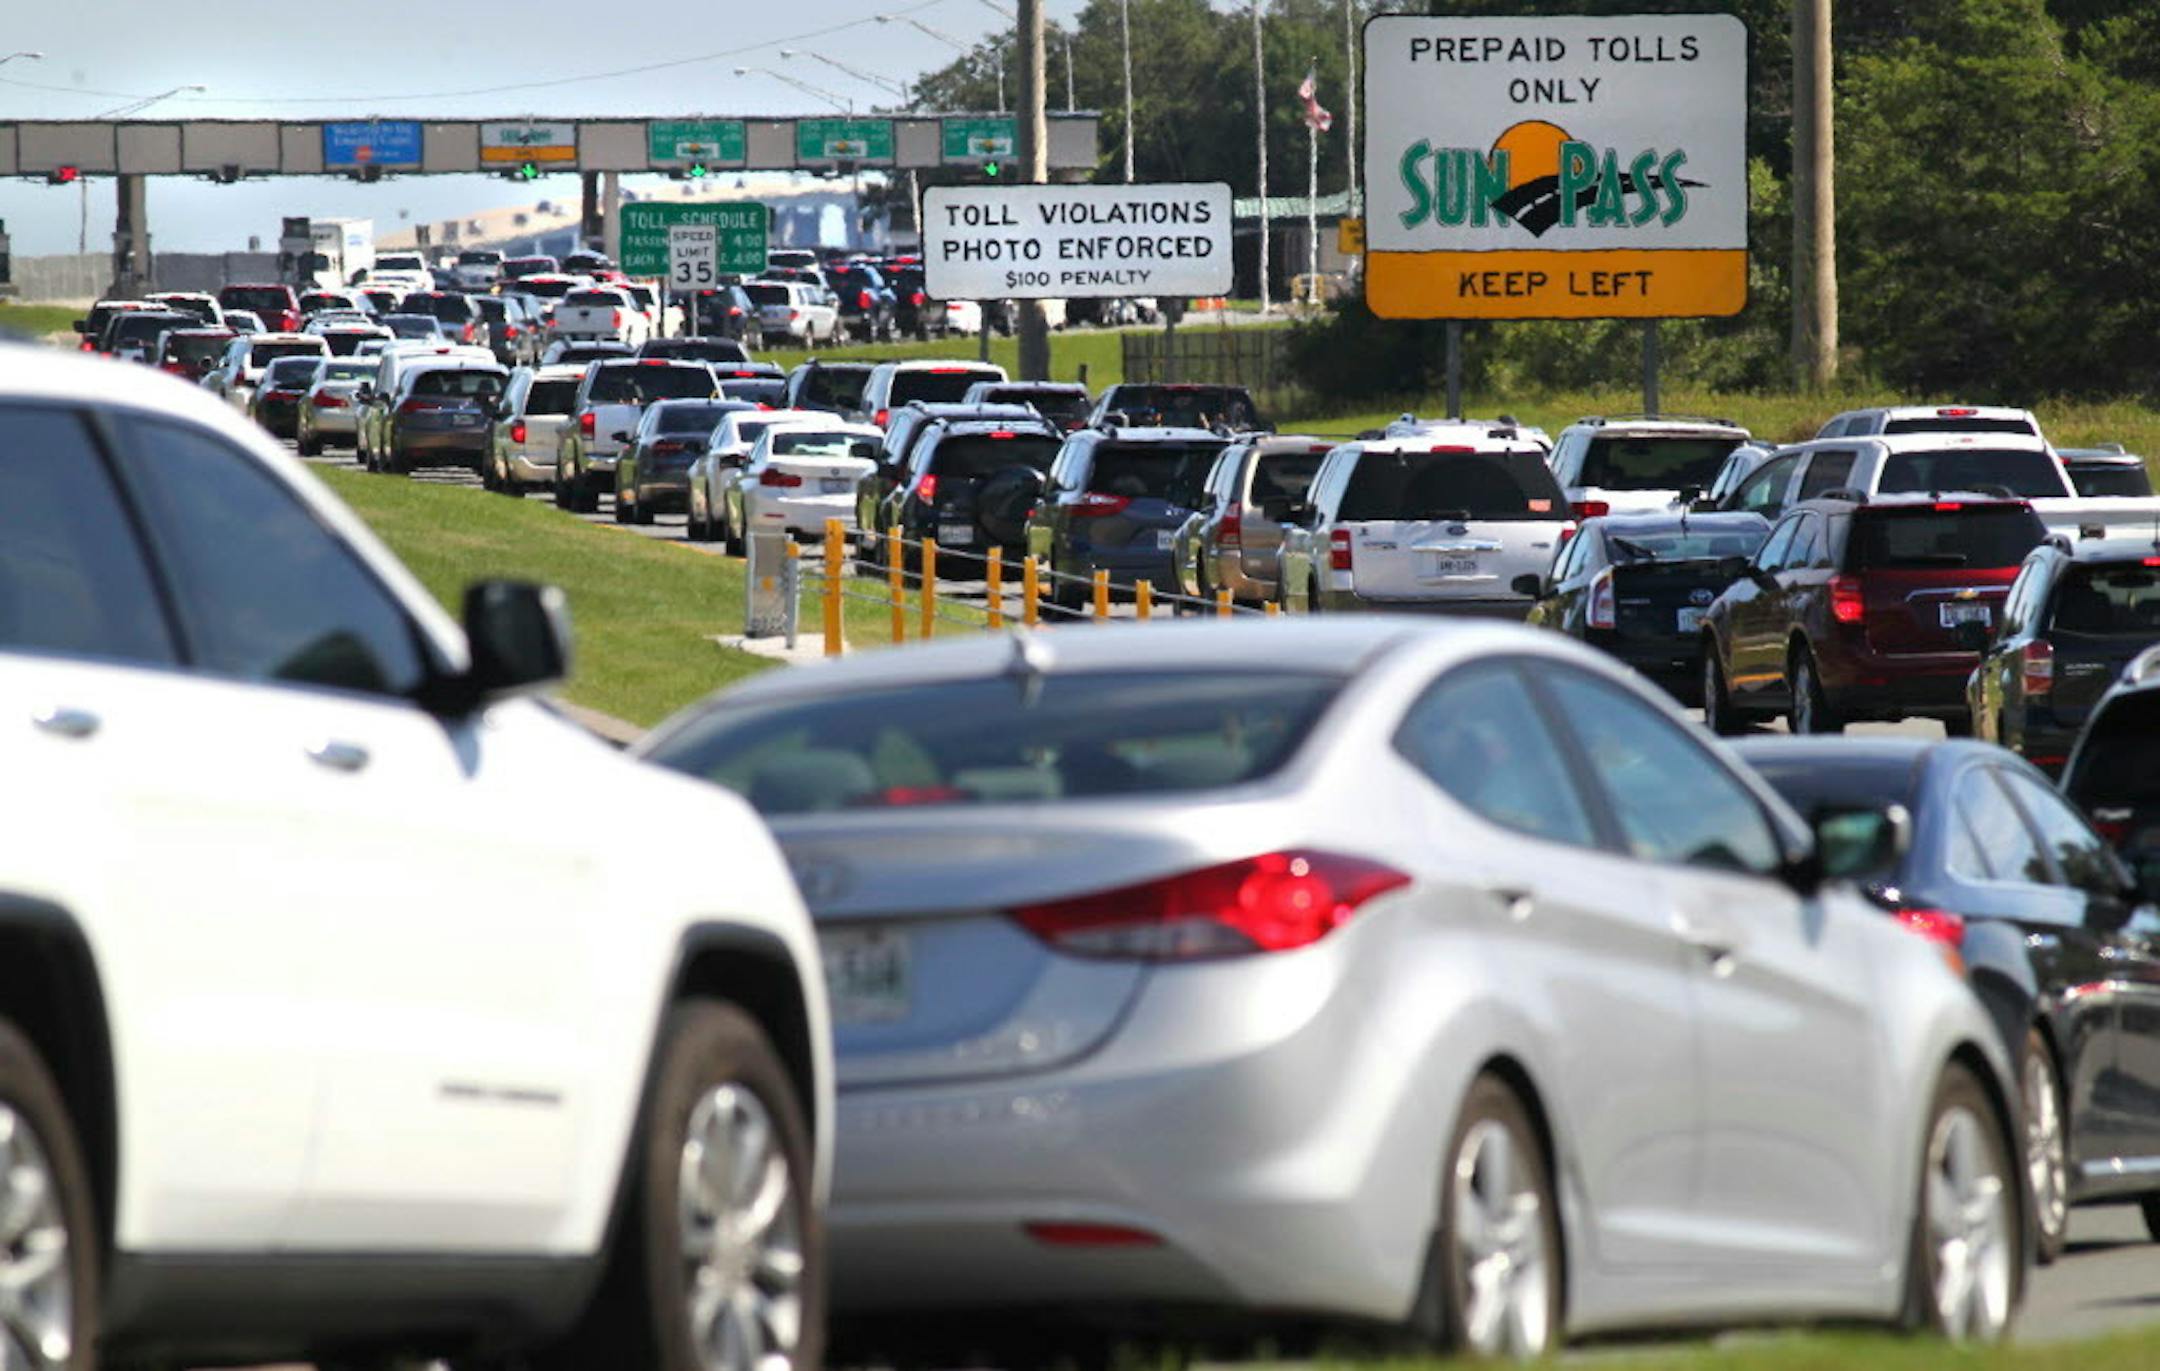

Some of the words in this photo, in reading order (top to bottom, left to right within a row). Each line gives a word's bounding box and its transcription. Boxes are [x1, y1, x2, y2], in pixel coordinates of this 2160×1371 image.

[1410, 36, 1566, 62] PREPAID
[1588, 35, 1700, 62] TOLLS
[1509, 77, 1601, 104] ONLY
[1399, 138, 1511, 230] SUN
[1559, 139, 1689, 229] PASS
[628, 211, 666, 229] TOLL
[680, 211, 759, 229] SCHEDULE
[945, 204, 1018, 227] TOLL
[1039, 200, 1212, 225] VIOLATIONS
[626, 236, 671, 249] PASSEN
[673, 230, 714, 242] SPEED
[676, 247, 710, 259] LIMIT
[943, 238, 1041, 262] PHOTO
[1058, 236, 1214, 260] ENFORCED
[676, 261, 713, 284] 35
[1005, 270, 1051, 289] $100
[1061, 269, 1151, 286] PENALTY
[1459, 271, 1549, 298] KEEP
[1569, 270, 1655, 297] LEFT
